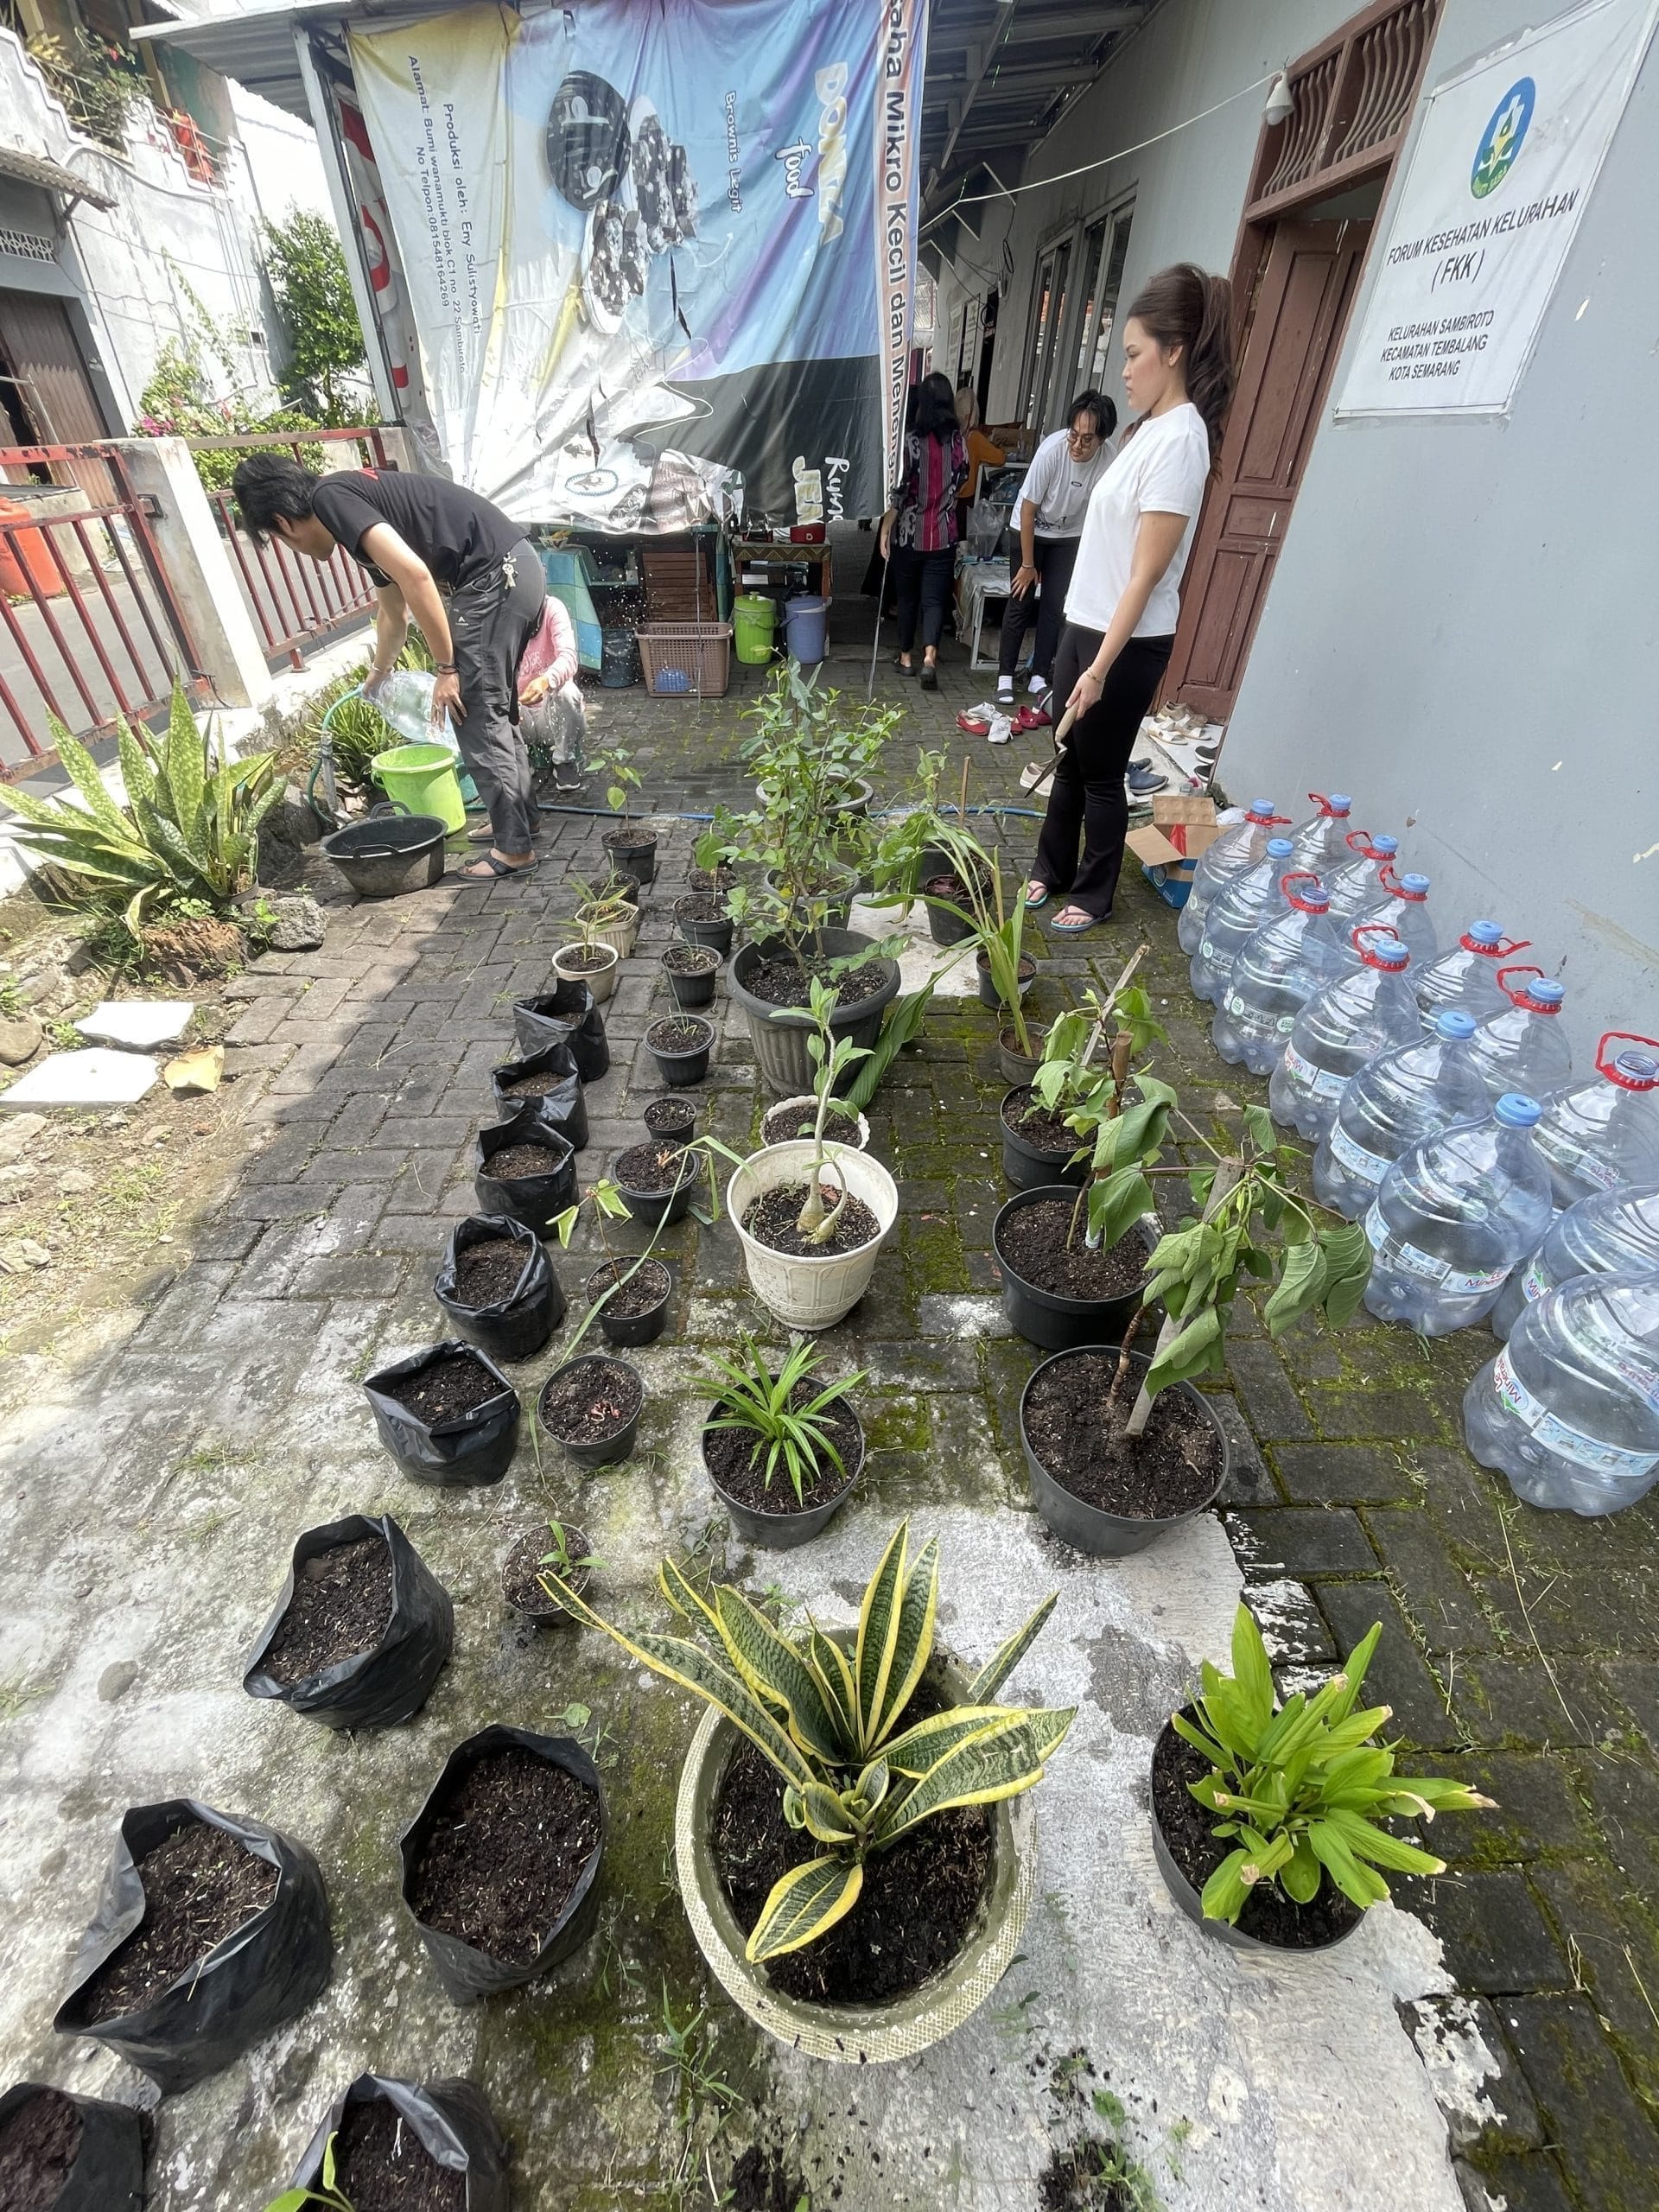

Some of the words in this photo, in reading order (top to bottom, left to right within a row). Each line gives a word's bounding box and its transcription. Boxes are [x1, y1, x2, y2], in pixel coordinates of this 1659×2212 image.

[424, 118, 437, 152] Bumi
[443, 104, 463, 169] Produksi
[725, 90, 741, 163] Brownis
[887, 92, 905, 192] Mikro
[416, 146, 425, 165] No
[776, 137, 814, 199] food
[430, 156, 448, 226] wanamukti
[455, 177, 468, 213] oleh:
[728, 168, 742, 213] Legit
[442, 230, 452, 255] blok
[461, 221, 473, 246] Eny
[887, 203, 906, 283] Kecil
[1387, 239, 1424, 266] FORUM
[1422, 218, 1492, 256] KESEHATAN
[1490, 188, 1580, 236] KELURAHAN
[447, 259, 455, 275] C1
[450, 279, 457, 293] no
[453, 301, 461, 313] 22
[467, 254, 482, 334] Sulistyowati
[891, 292, 906, 348] dan
[1388, 321, 1439, 342] KELURAHAN
[1438, 309, 1494, 334] SAMBIROTO
[454, 316, 465, 373] Sambiroto
[1381, 342, 1430, 362] KECAMATAN
[1430, 334, 1488, 357] TEMBALANG
[1389, 364, 1411, 381] KOTA
[1411, 359, 1461, 379] SEMARANG
